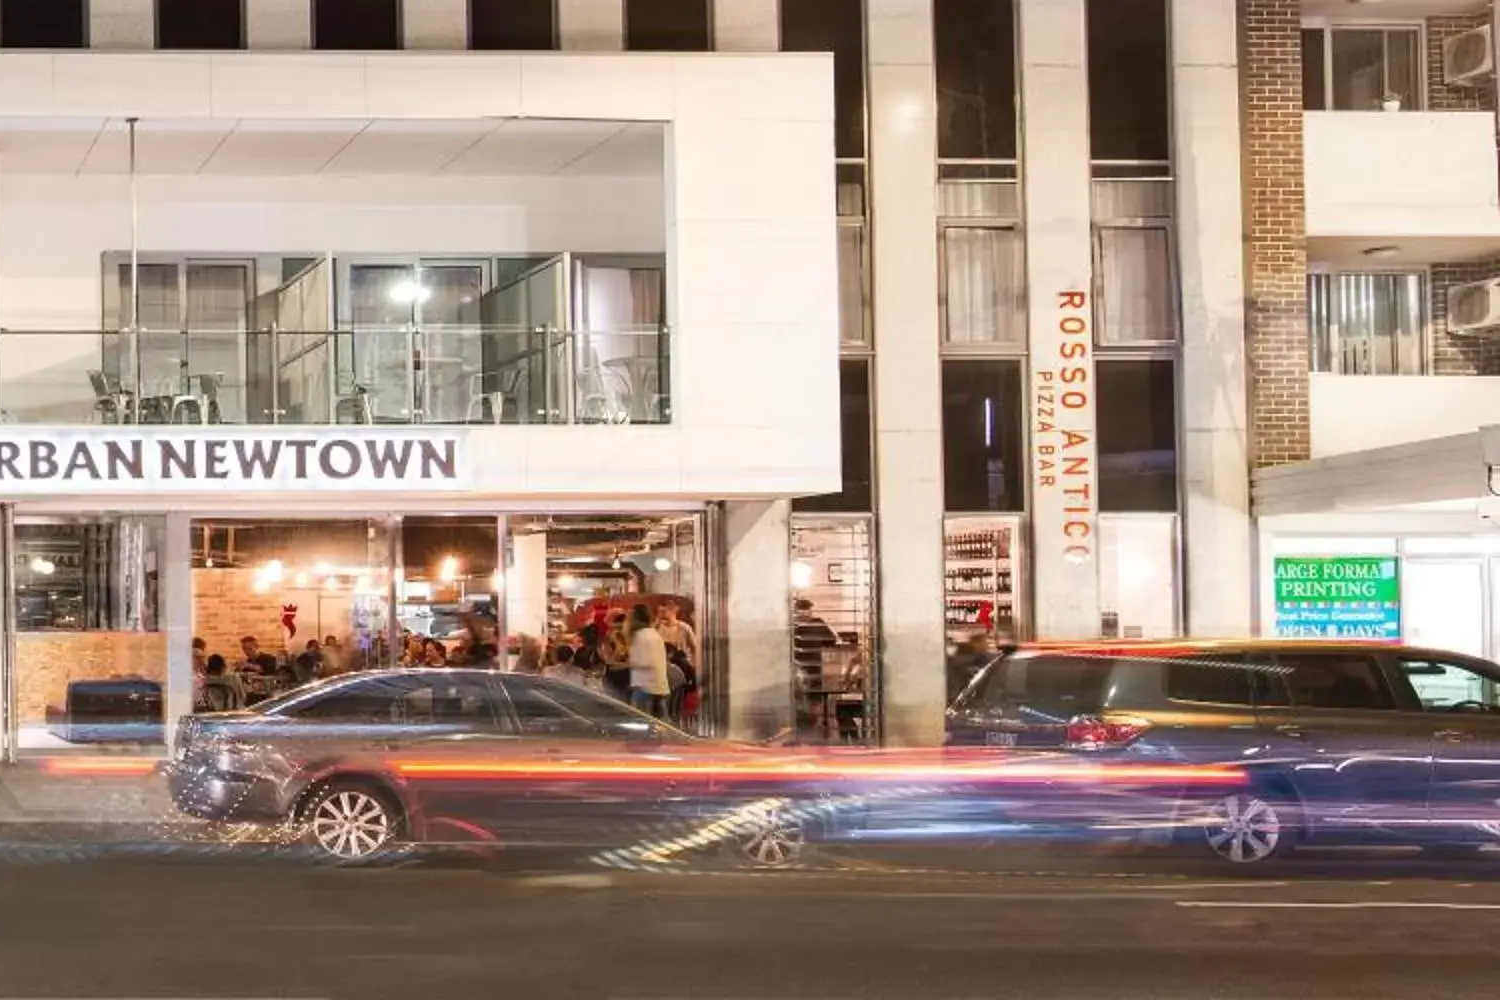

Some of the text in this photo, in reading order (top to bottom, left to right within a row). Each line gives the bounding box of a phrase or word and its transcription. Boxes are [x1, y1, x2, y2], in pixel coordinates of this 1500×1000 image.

[1057, 290, 1087, 409] ROSSO
[1036, 370, 1056, 487] PIZZA BAR
[156, 438, 457, 480] NEWTOWN
[1275, 563, 1384, 579] ARGE FORMA
[1280, 581, 1377, 597] PRINTING
